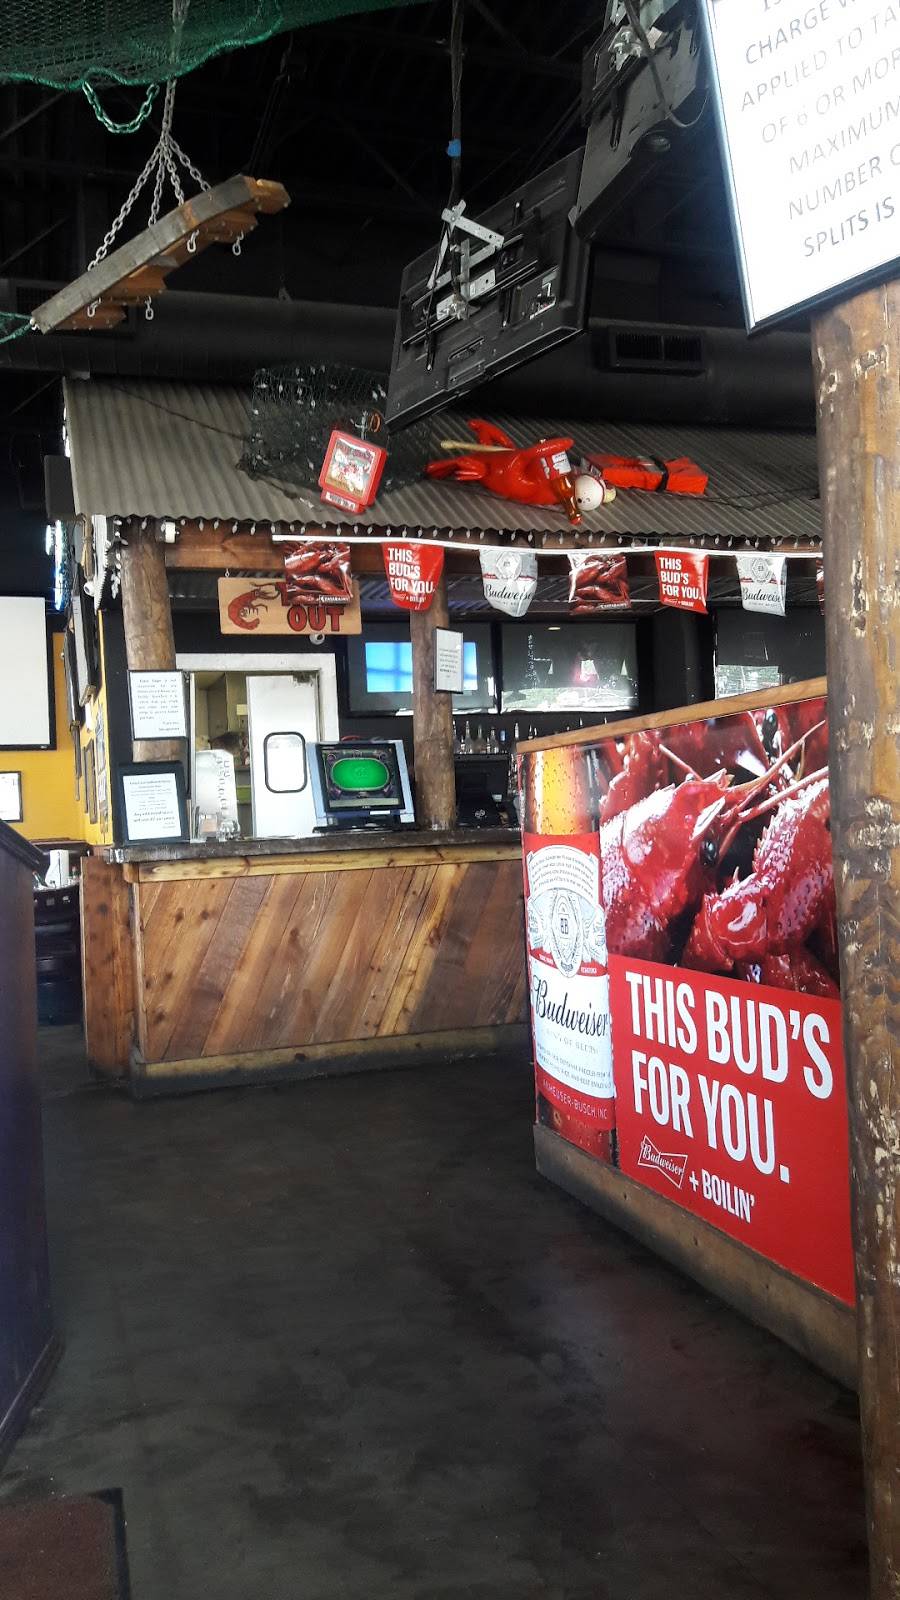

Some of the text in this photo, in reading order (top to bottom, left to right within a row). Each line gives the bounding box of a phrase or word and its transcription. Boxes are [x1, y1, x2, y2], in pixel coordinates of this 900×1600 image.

[745, 0, 830, 64] CHARGE
[741, 50, 827, 112] APPLIED
[836, 27, 863, 56] TO
[762, 115, 787, 143] OF
[796, 104, 808, 127] 6
[816, 85, 846, 116] OR
[788, 156, 882, 220] NUMBER
[804, 196, 895, 257] SPLITS IS
[387, 547, 413, 563] THIS
[388, 563, 421, 581] BUD'S
[659, 557, 682, 571] THIS
[660, 571, 689, 584] BUD'S
[389, 577, 411, 592] FOR
[662, 585, 680, 598] FOR
[287, 605, 345, 632] OUT
[533, 974, 607, 1037] Budweiser
[626, 971, 834, 1099] THIS BUD'S
[632, 1050, 790, 1184] FOR YOU.
[641, 1139, 684, 1177] Budweiser
[702, 1168, 754, 1224] BOILIN'
